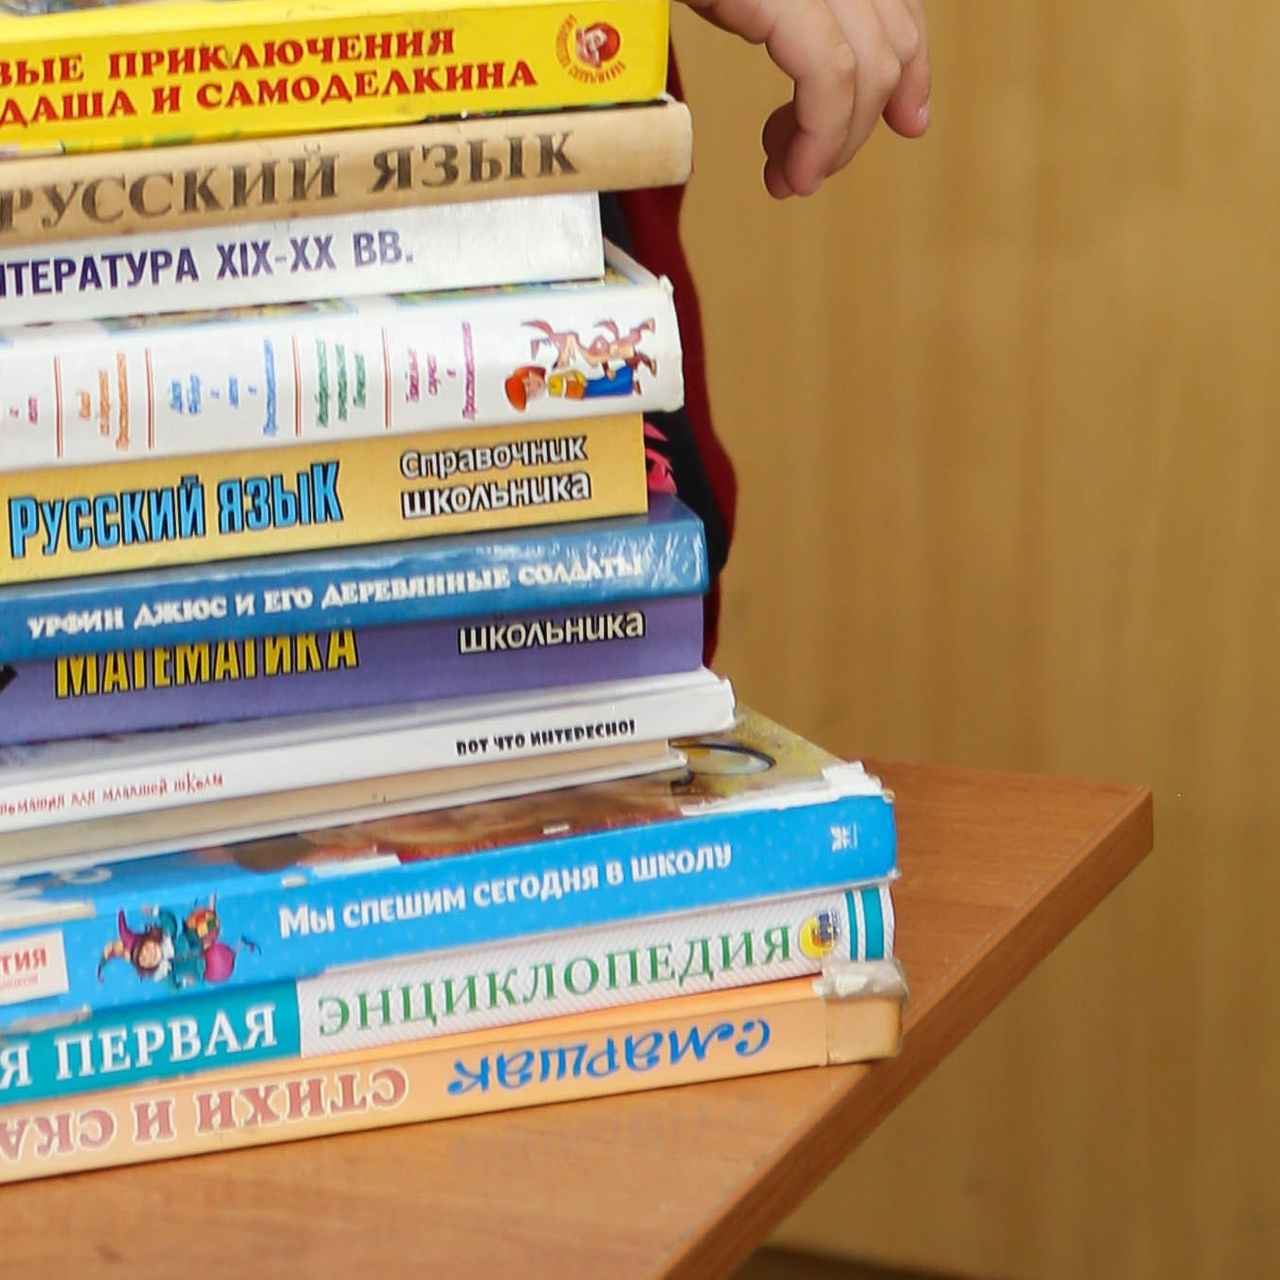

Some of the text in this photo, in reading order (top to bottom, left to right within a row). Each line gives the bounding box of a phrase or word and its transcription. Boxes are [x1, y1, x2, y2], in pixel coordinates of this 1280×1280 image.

[108, 28, 455, 80] ПРИКЛЮЧЕНИЯ
[152, 85, 181, 115] И
[196, 60, 538, 109] САМОДЕЛКИНА
[370, 131, 580, 194] ЯЗЫК
[353, 230, 414, 269] ВВ.
[400, 435, 588, 480] Справочник
[7, 460, 345, 558] РУССКИЙ ЯЗЫК
[401, 470, 592, 520] школьника
[26, 606, 124, 640] УРФИН
[132, 595, 227, 630] ДЖЮС
[233, 593, 255, 617] И
[263, 586, 313, 615] ЕГО
[320, 564, 511, 608] ДЕРЕВЯННЫЕ
[518, 553, 645, 588] СОЛДАТЫ
[458, 609, 645, 655] школьника
[493, 733, 526, 752] ЧТО
[530, 719, 635, 748] ИНТЕРЕСНО!
[279, 841, 733, 939] Мы спешим сегодня в школу
[54, 1003, 278, 1081] ПЕРВАЯ
[317, 922, 794, 1037] ЭНЦИКЛОПЕДИЯ
[131, 1097, 175, 1146] И
[194, 1066, 409, 1136] СТИХИ
